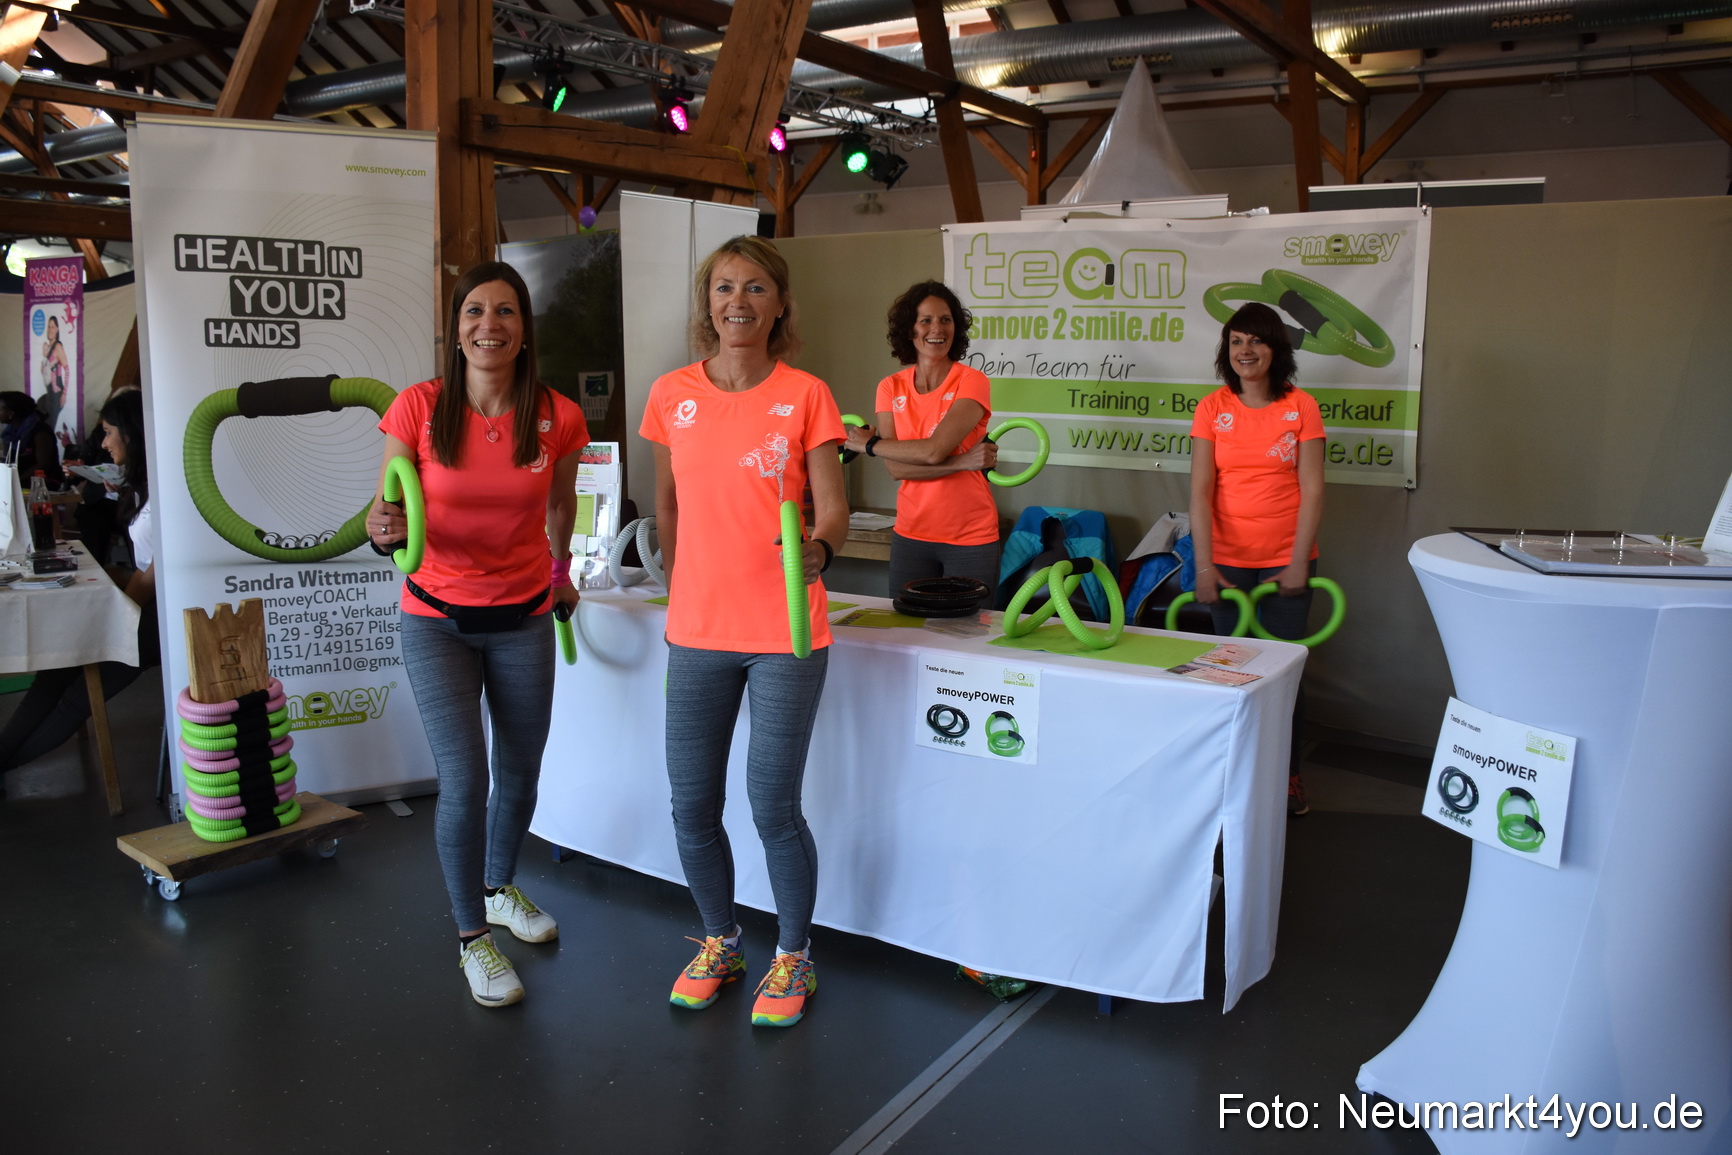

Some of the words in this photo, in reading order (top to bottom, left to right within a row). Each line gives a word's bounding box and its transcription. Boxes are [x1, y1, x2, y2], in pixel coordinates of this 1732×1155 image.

[345, 165, 427, 178] www.smovey.com
[178, 237, 322, 274] HEALTH
[331, 249, 359, 276] IN
[1283, 233, 1400, 262] smovey
[964, 232, 1187, 300] team
[1305, 256, 1327, 264] health
[1328, 256, 1335, 264] in
[1336, 257, 1352, 265] your
[1353, 255, 1374, 263] hands
[29, 264, 78, 286] KANGA
[34, 282, 76, 297] TRAINING
[234, 278, 342, 317] YOUR
[208, 321, 296, 346] HANDS
[967, 352, 1016, 376] Dein
[1026, 352, 1089, 379] Team
[1095, 354, 1136, 388] für
[1067, 388, 1150, 416] Training
[1172, 393, 1198, 413] Be
[1319, 399, 1395, 421] erkauf
[224, 573, 294, 594] Sandra
[297, 569, 394, 588] Wittmann
[264, 587, 367, 609] moveyCOACH
[268, 609, 329, 626] Beratug
[341, 602, 398, 619] Verkauf
[267, 633, 276, 643] n
[280, 627, 300, 642] 29
[314, 621, 364, 640] 92367
[368, 620, 401, 634] Pilsa
[269, 656, 404, 678] ittmann10@gmx.
[925, 664, 939, 673] Teste
[286, 686, 390, 719] movey
[936, 686, 1015, 706] smoveyPOWER
[291, 719, 307, 729] alth
[308, 718, 316, 727] in
[318, 717, 336, 728] your
[337, 714, 362, 723] hands
[1450, 713, 1461, 725] Teste
[1468, 723, 1481, 734] neuen
[1452, 743, 1538, 783] smoveyPOWER
